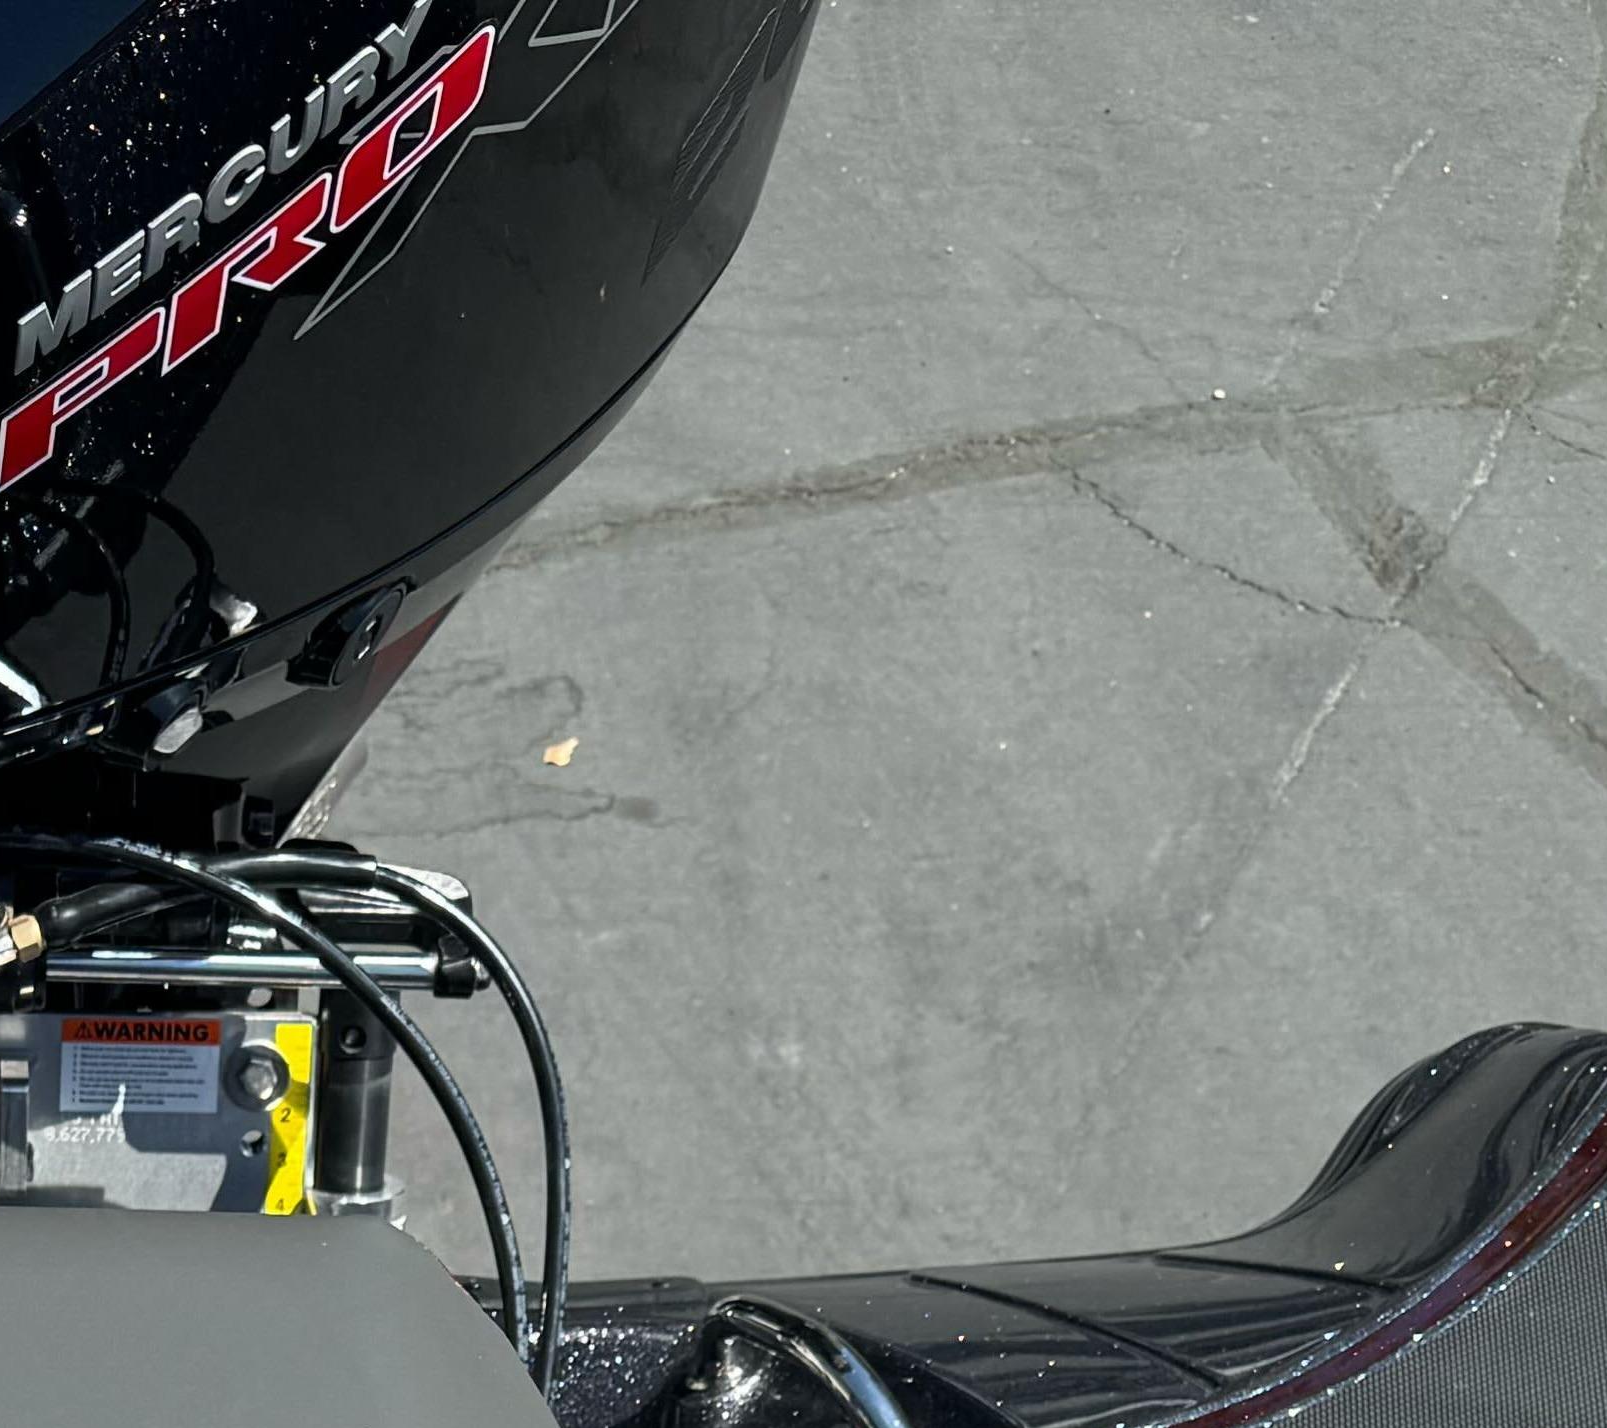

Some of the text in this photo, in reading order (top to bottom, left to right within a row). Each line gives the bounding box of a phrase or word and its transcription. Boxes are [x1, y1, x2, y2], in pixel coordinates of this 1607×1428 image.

[14, 0, 432, 376] MERCURY
[94, 1021, 209, 1042] WARNING
[280, 1107, 292, 1124] 2
